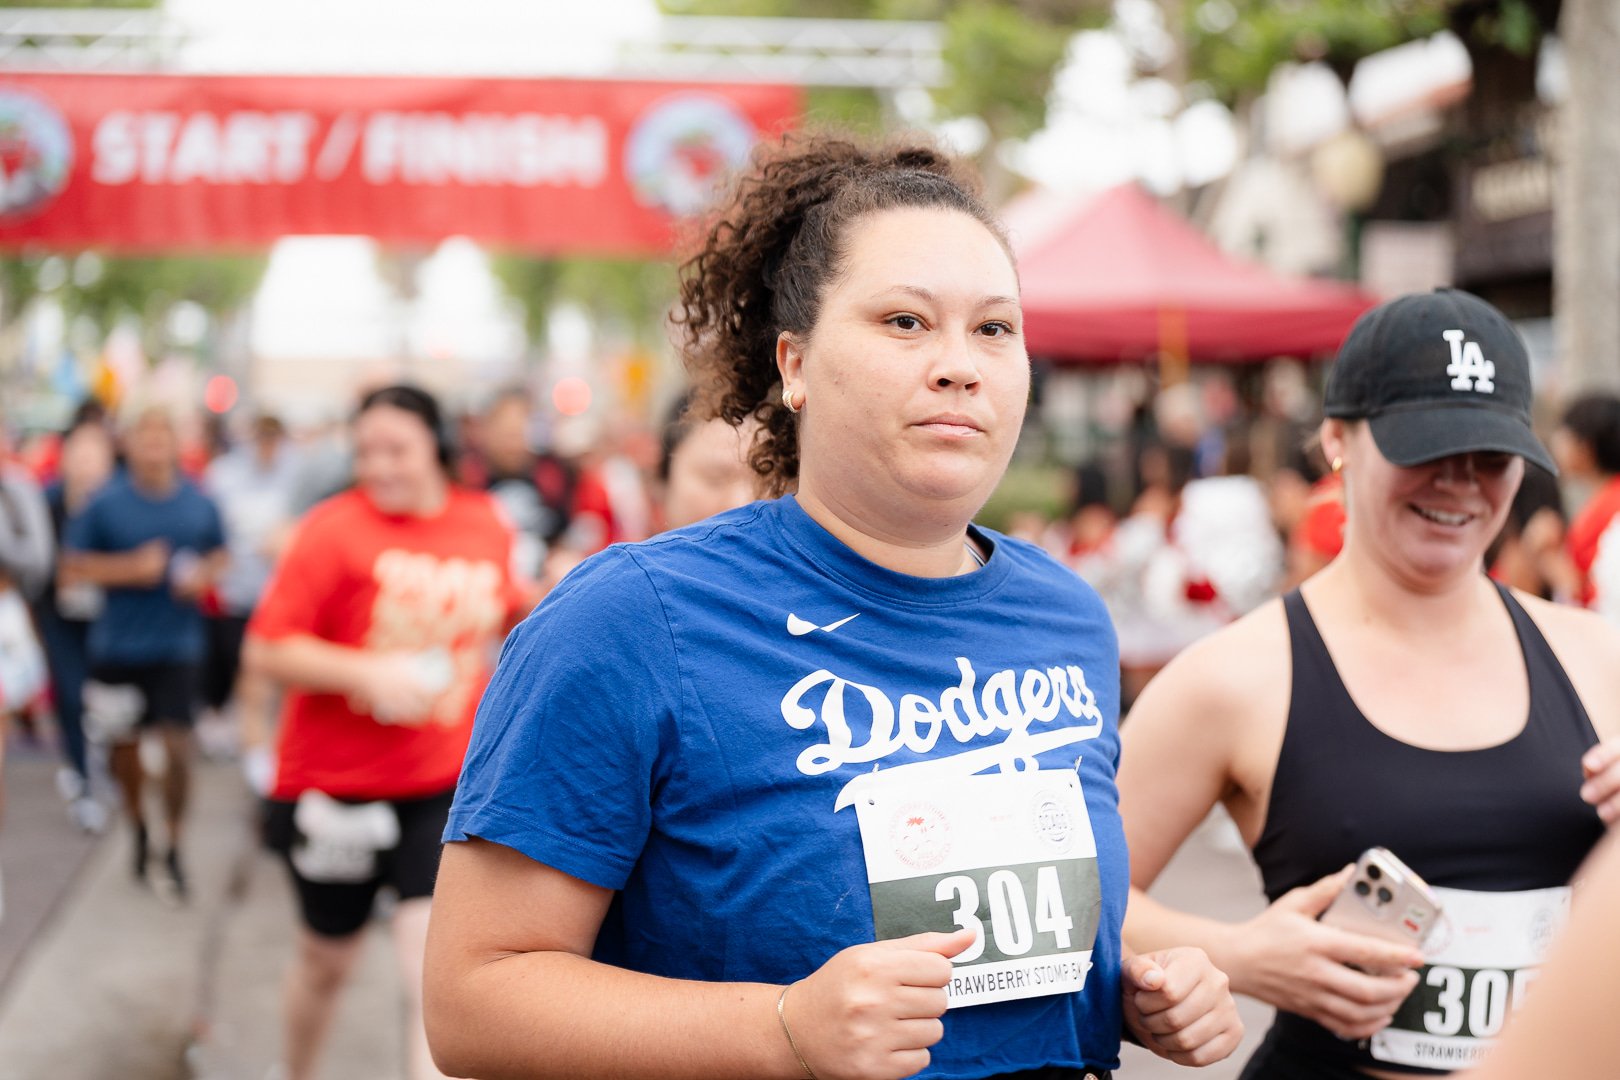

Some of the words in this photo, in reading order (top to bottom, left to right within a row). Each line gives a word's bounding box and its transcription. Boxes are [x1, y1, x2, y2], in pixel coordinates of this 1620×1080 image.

[92, 110, 314, 184] START
[361, 111, 608, 187] FINISH
[1443, 329, 1496, 394] LA
[780, 656, 1103, 776] Dodgers
[935, 865, 1074, 964] 304
[947, 968, 1031, 997] TRAWBERRY
[1034, 963, 1069, 985] STOMP
